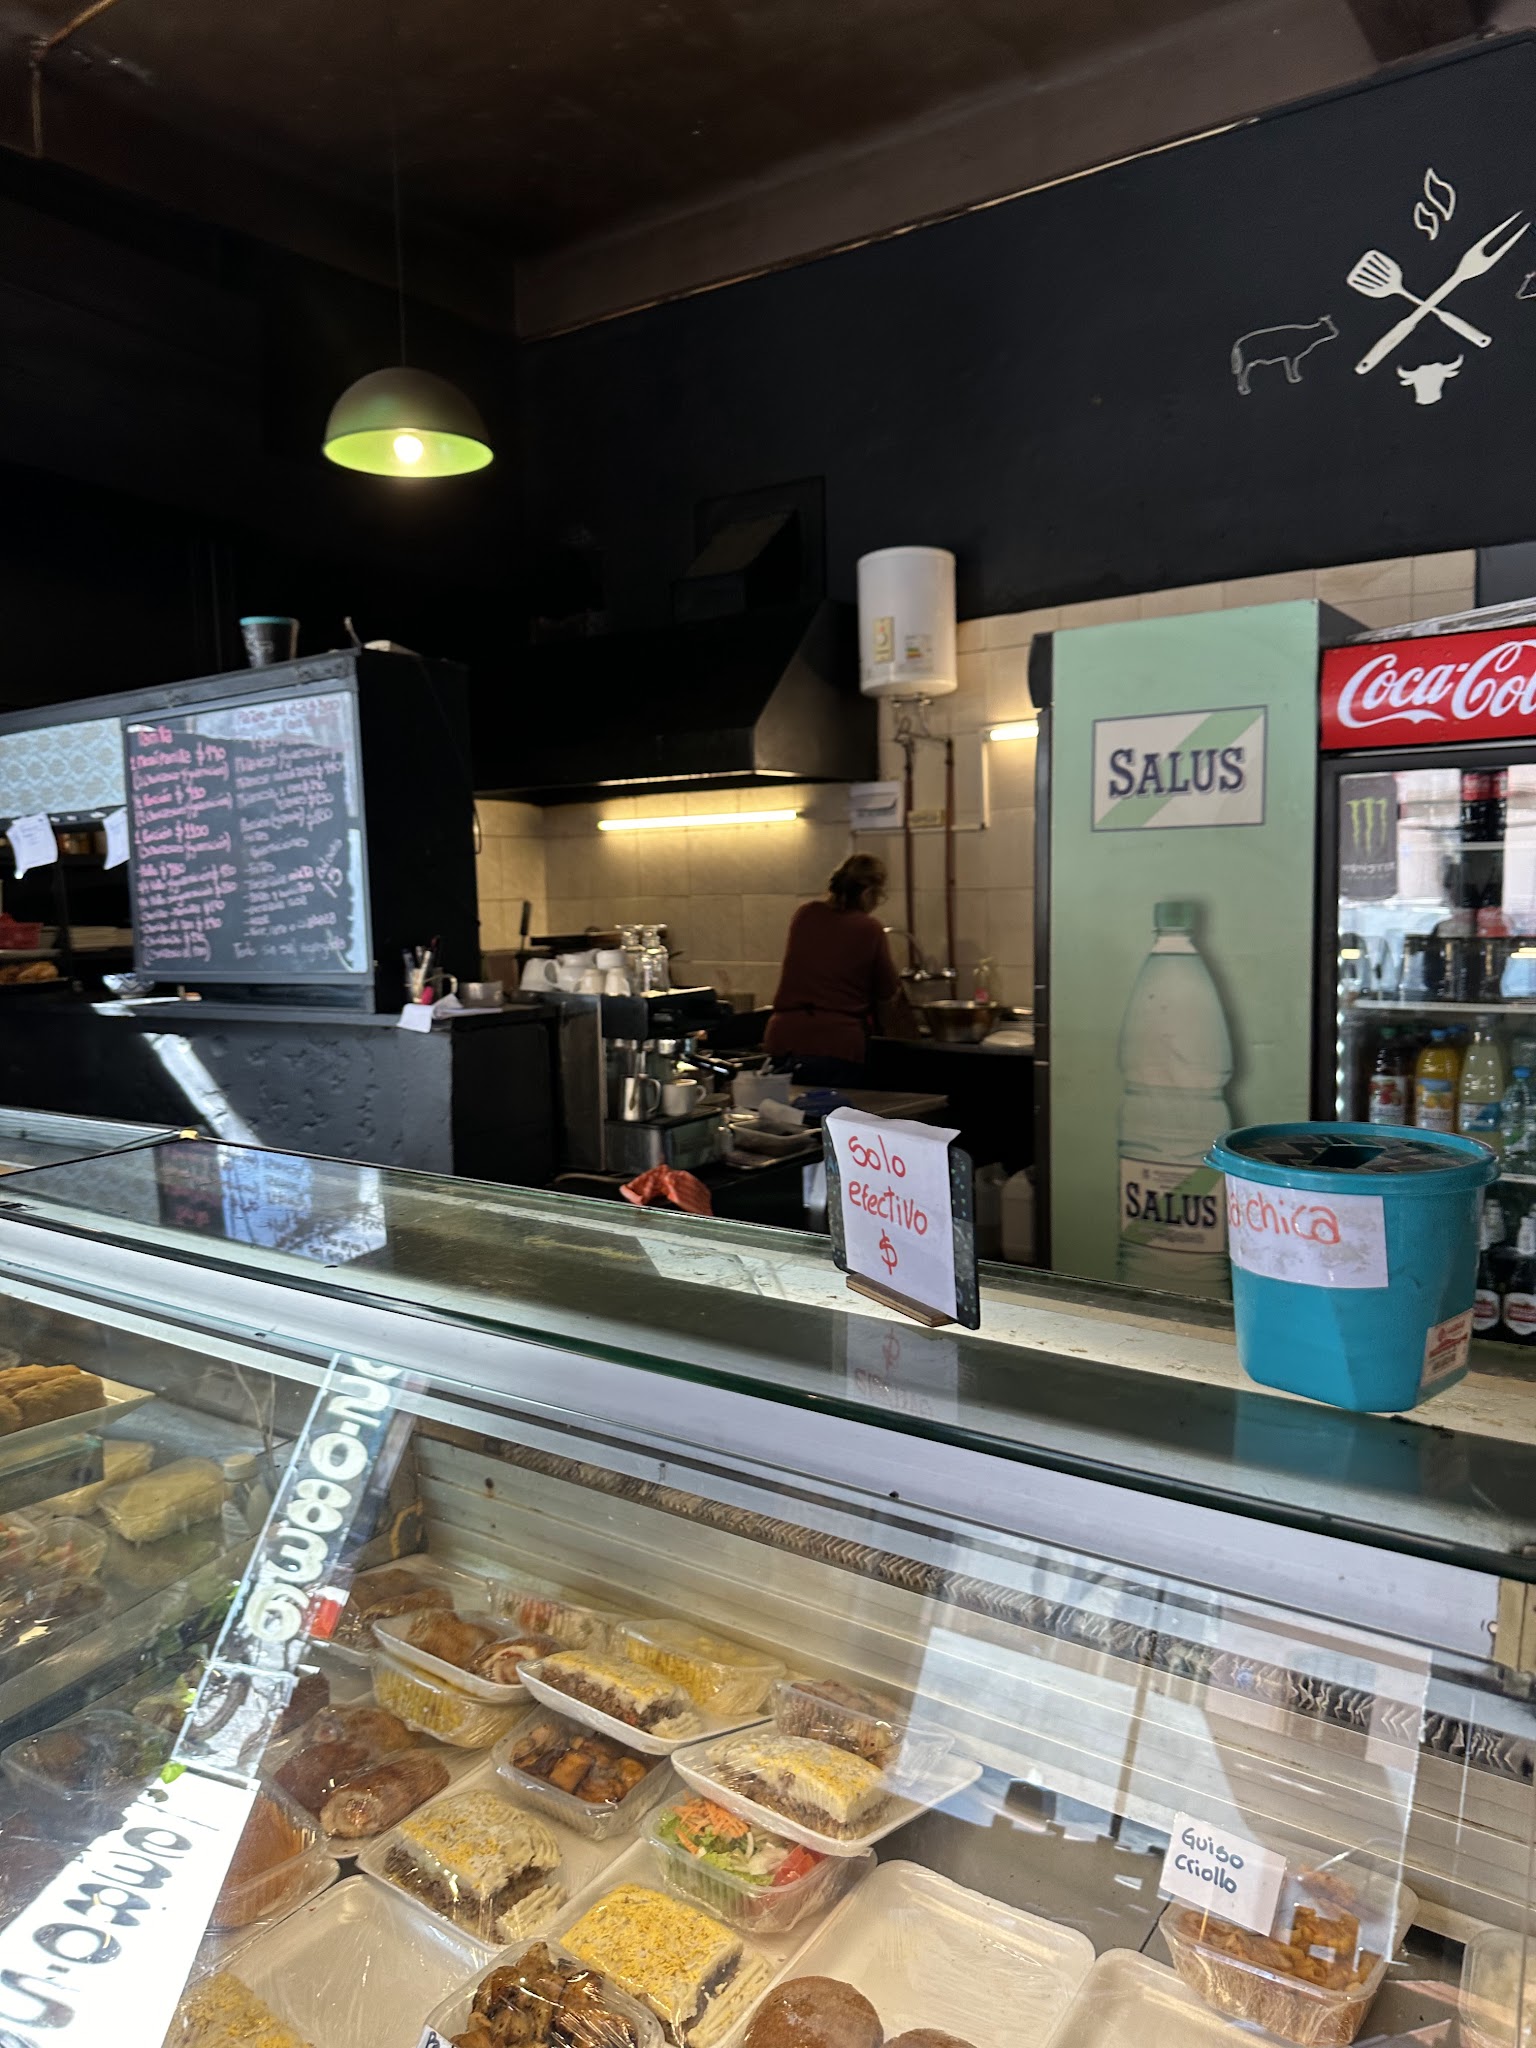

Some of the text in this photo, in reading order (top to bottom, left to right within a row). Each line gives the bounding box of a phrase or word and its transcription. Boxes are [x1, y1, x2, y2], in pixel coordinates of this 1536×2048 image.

[1109, 746, 1245, 798] SALUS
[1125, 1181, 1218, 1228] SALUS
[1246, 1191, 1341, 1245] chica
[878, 1228, 899, 1276] $
[1181, 1827, 1244, 1869] Guiso
